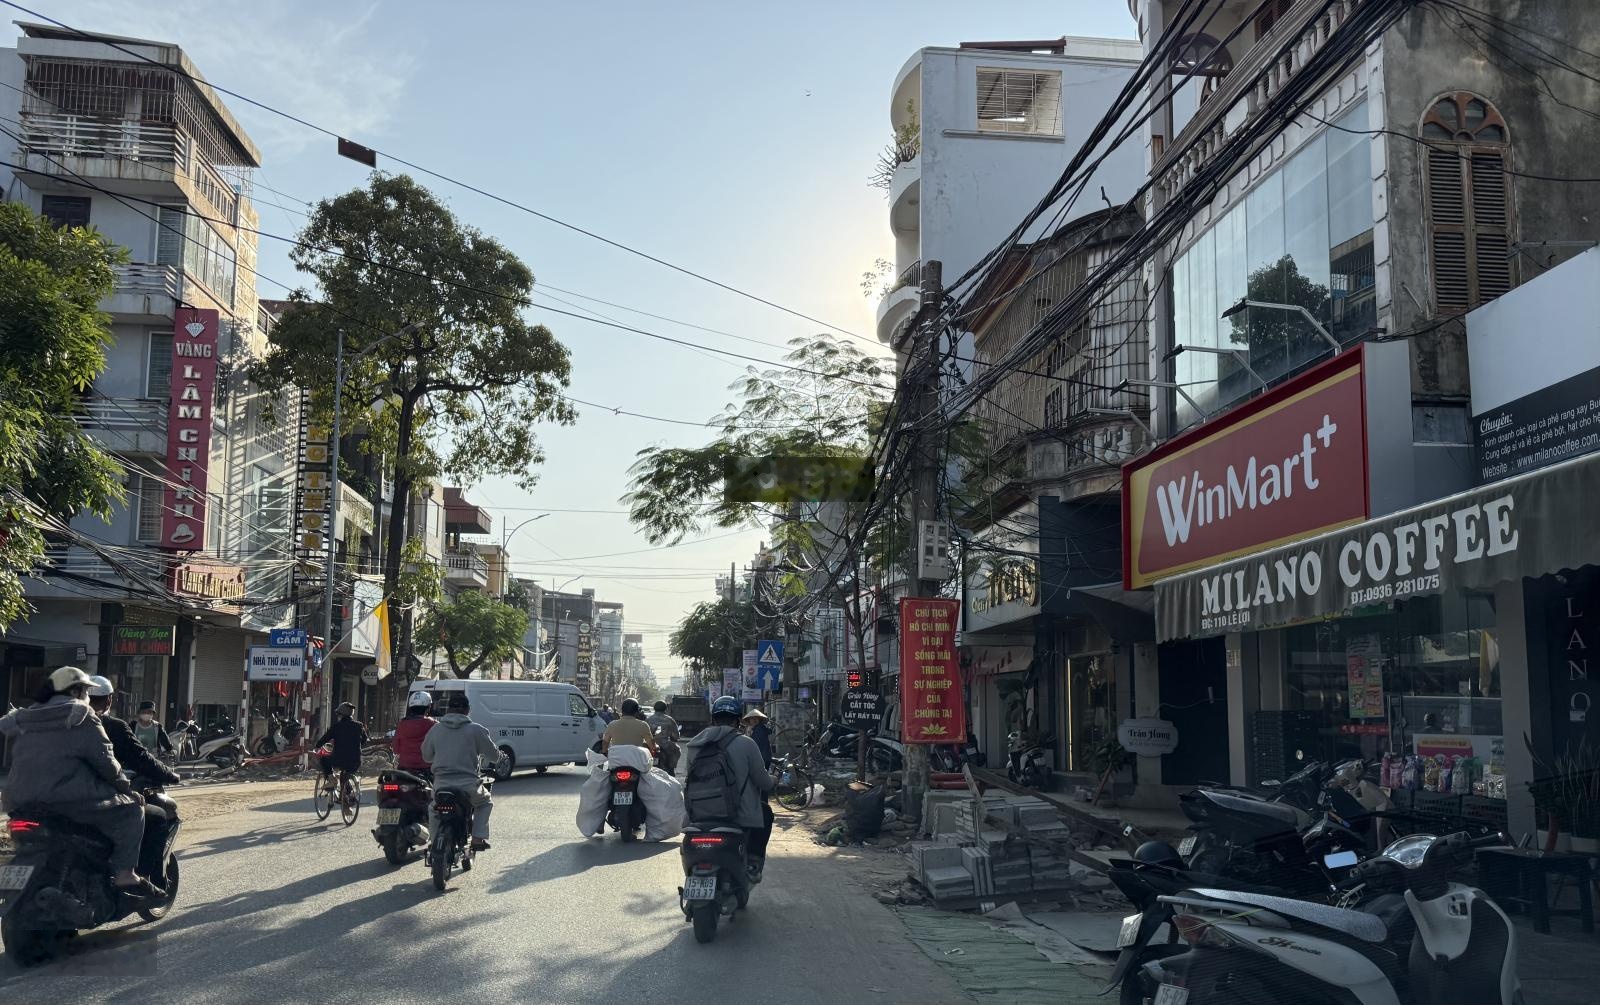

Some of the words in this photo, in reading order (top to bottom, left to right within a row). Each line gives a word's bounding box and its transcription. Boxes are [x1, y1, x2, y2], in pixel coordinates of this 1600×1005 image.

[176, 340, 212, 358] VÀNG
[177, 364, 202, 420] LÂM
[1156, 414, 1338, 548] WinMart+
[1200, 551, 1322, 616] MILANO
[1338, 494, 1519, 588] COFFEE
[1395, 574, 1440, 598] 281075
[1214, 616, 1227, 628] 110
[1228, 610, 1237, 625] LÊ
[253, 655, 266, 666] NHÀ
[267, 655, 279, 666] THỜ
[280, 657, 289, 666] AN
[291, 655, 301, 666] HẢI
[922, 665, 945, 675] TRONG
[926, 680, 952, 690] NGHIỆP
[915, 707, 940, 719] CHÚNG
